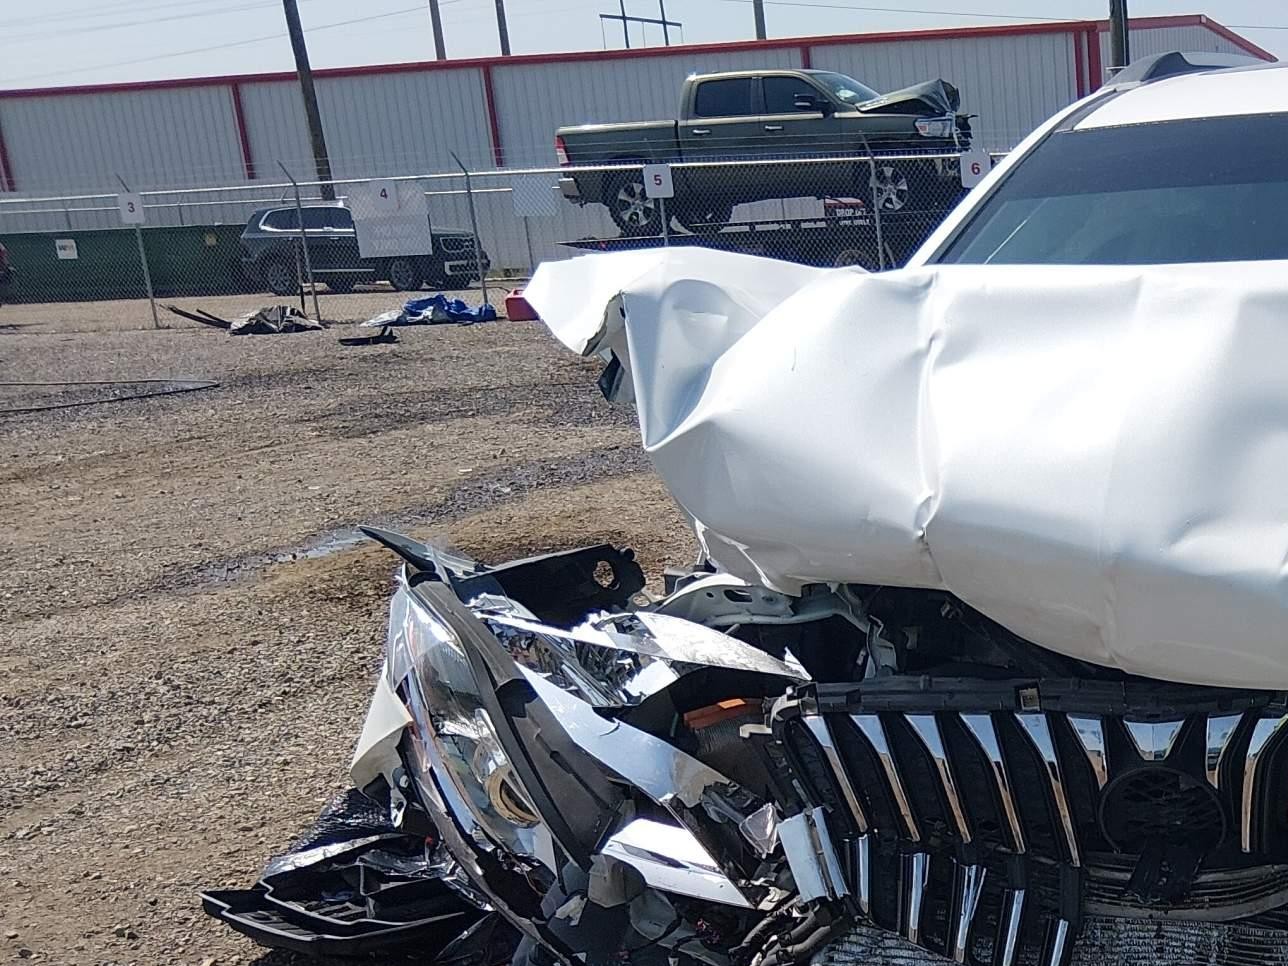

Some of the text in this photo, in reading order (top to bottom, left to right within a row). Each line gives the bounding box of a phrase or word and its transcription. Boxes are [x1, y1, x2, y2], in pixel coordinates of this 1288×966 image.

[971, 162, 981, 176] 6
[653, 174, 663, 186] 5
[380, 188, 388, 199] 4
[127, 201, 136, 213] 3
